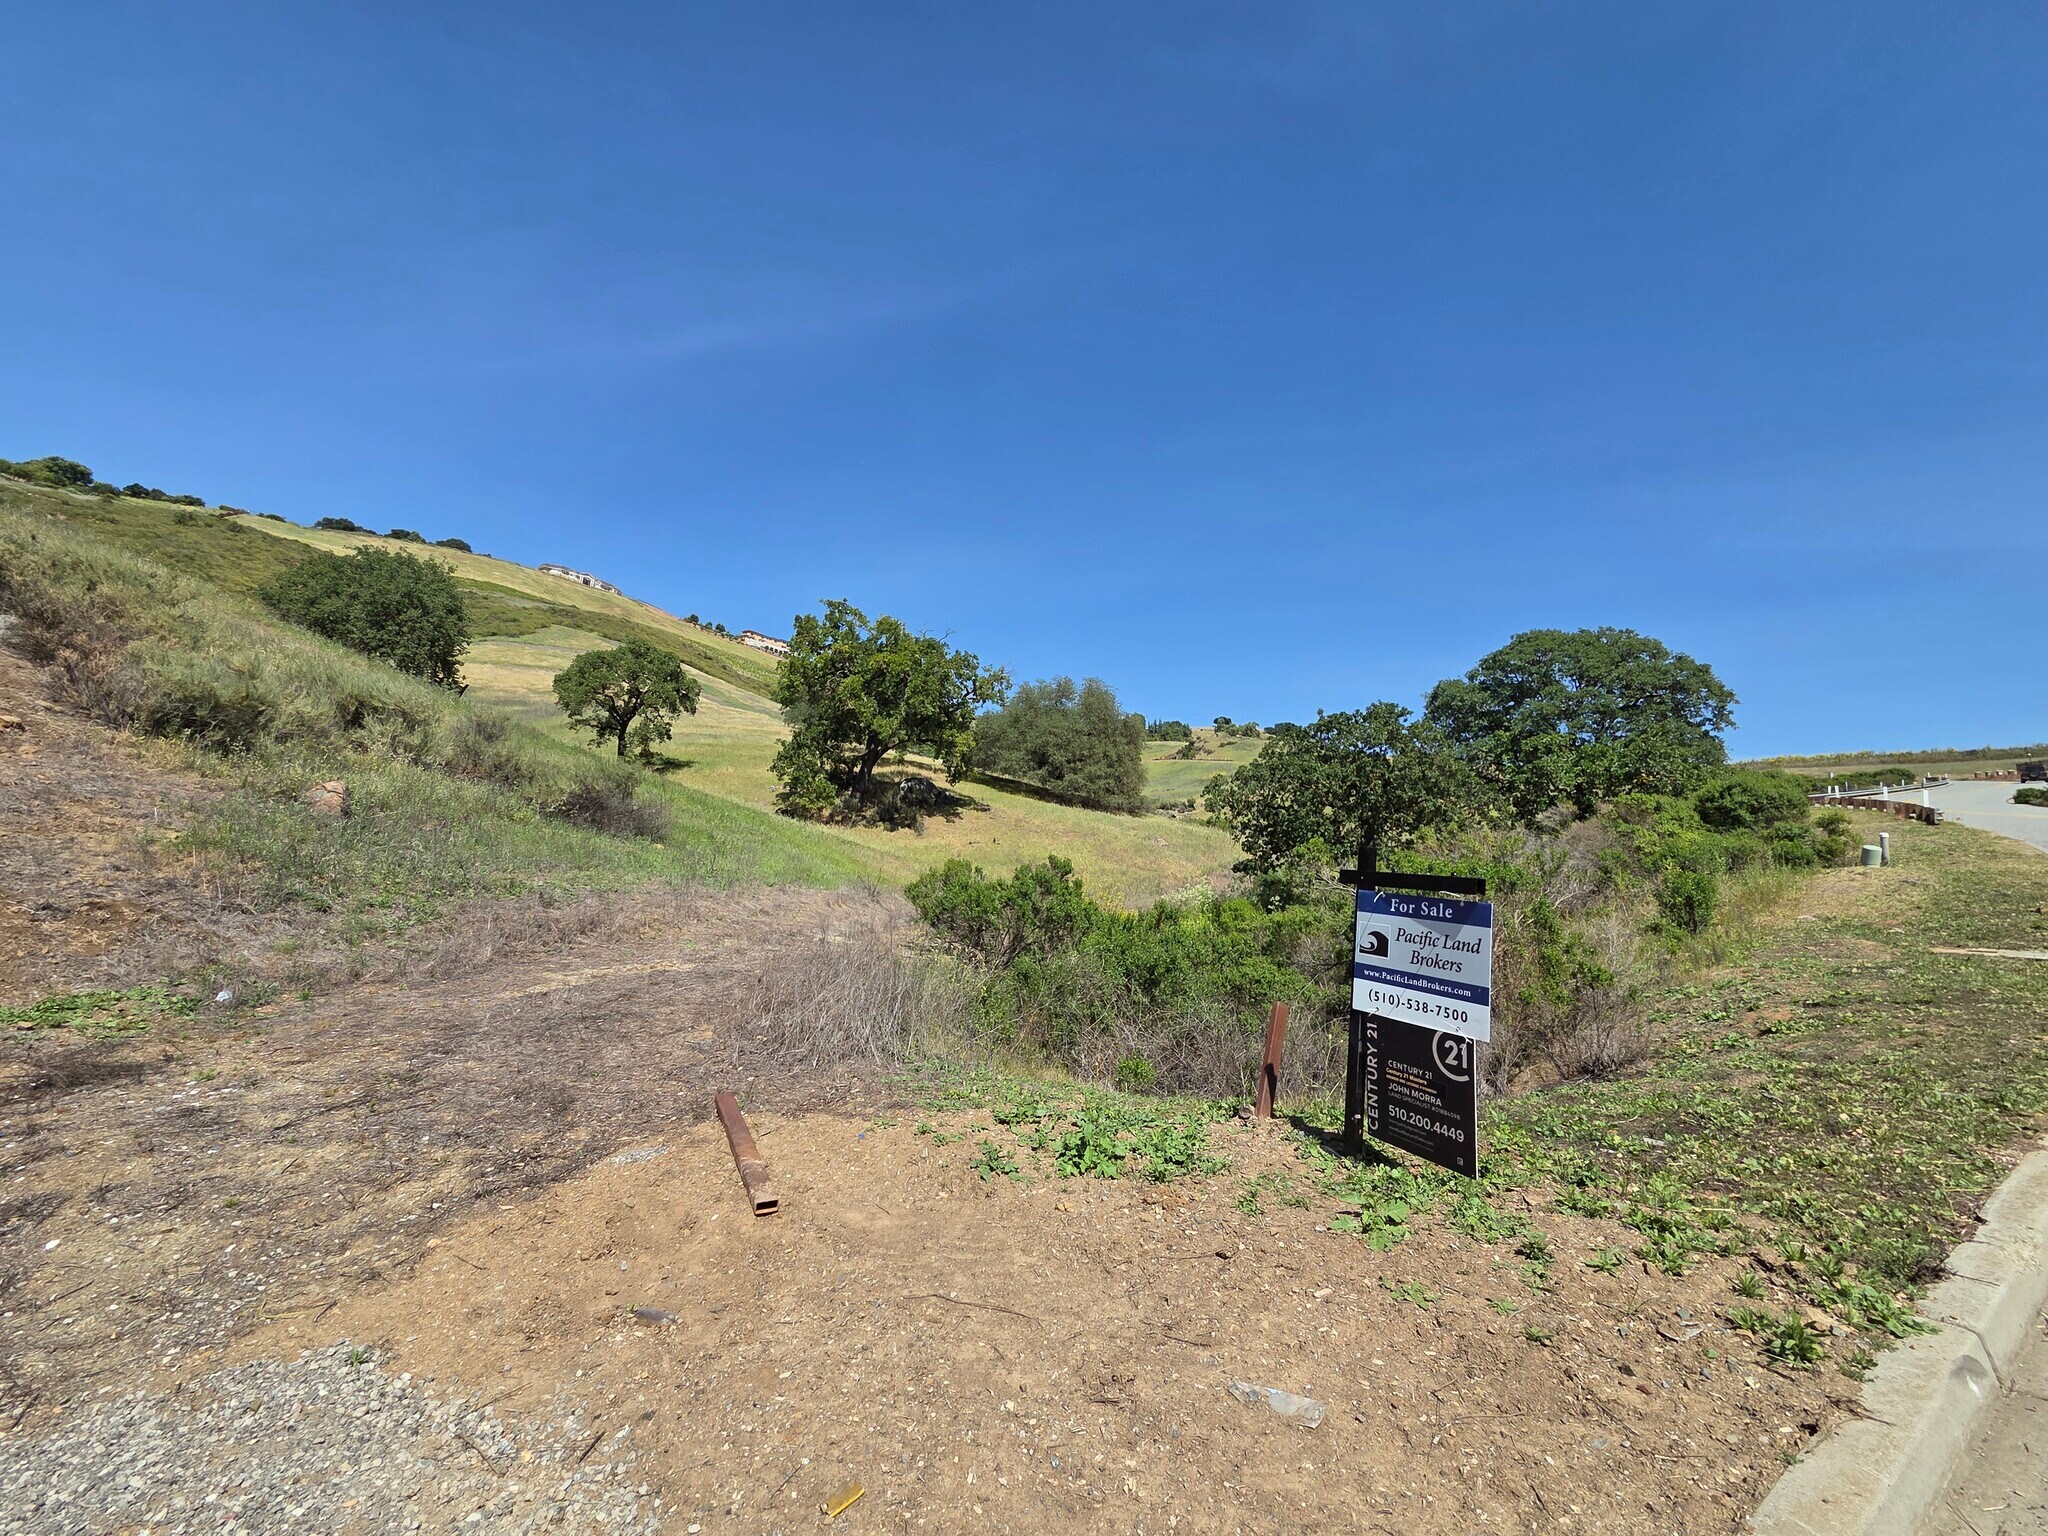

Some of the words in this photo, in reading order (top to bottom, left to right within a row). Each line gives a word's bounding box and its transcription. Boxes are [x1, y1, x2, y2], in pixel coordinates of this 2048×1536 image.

[1390, 898, 1415, 914] For
[1420, 901, 1453, 918] Sale
[1395, 927, 1440, 950] Pacific
[1442, 934, 1482, 954] Land
[1409, 950, 1463, 973] Brokers
[1363, 968, 1472, 997] www.PacificLandBrokers.com
[1368, 988, 1468, 1023] (510)-538-7500
[1366, 1022, 1378, 1040] 21
[1444, 1039, 1468, 1069] 21
[1387, 1060, 1423, 1077] CENTURY
[1424, 1071, 1433, 1080] 21
[1366, 1042, 1379, 1131] CENTURY
[1388, 1082, 1410, 1096] JOHN
[1411, 1089, 1442, 1107] MORRA
[1388, 1104, 1465, 1143] 510.200.4449
